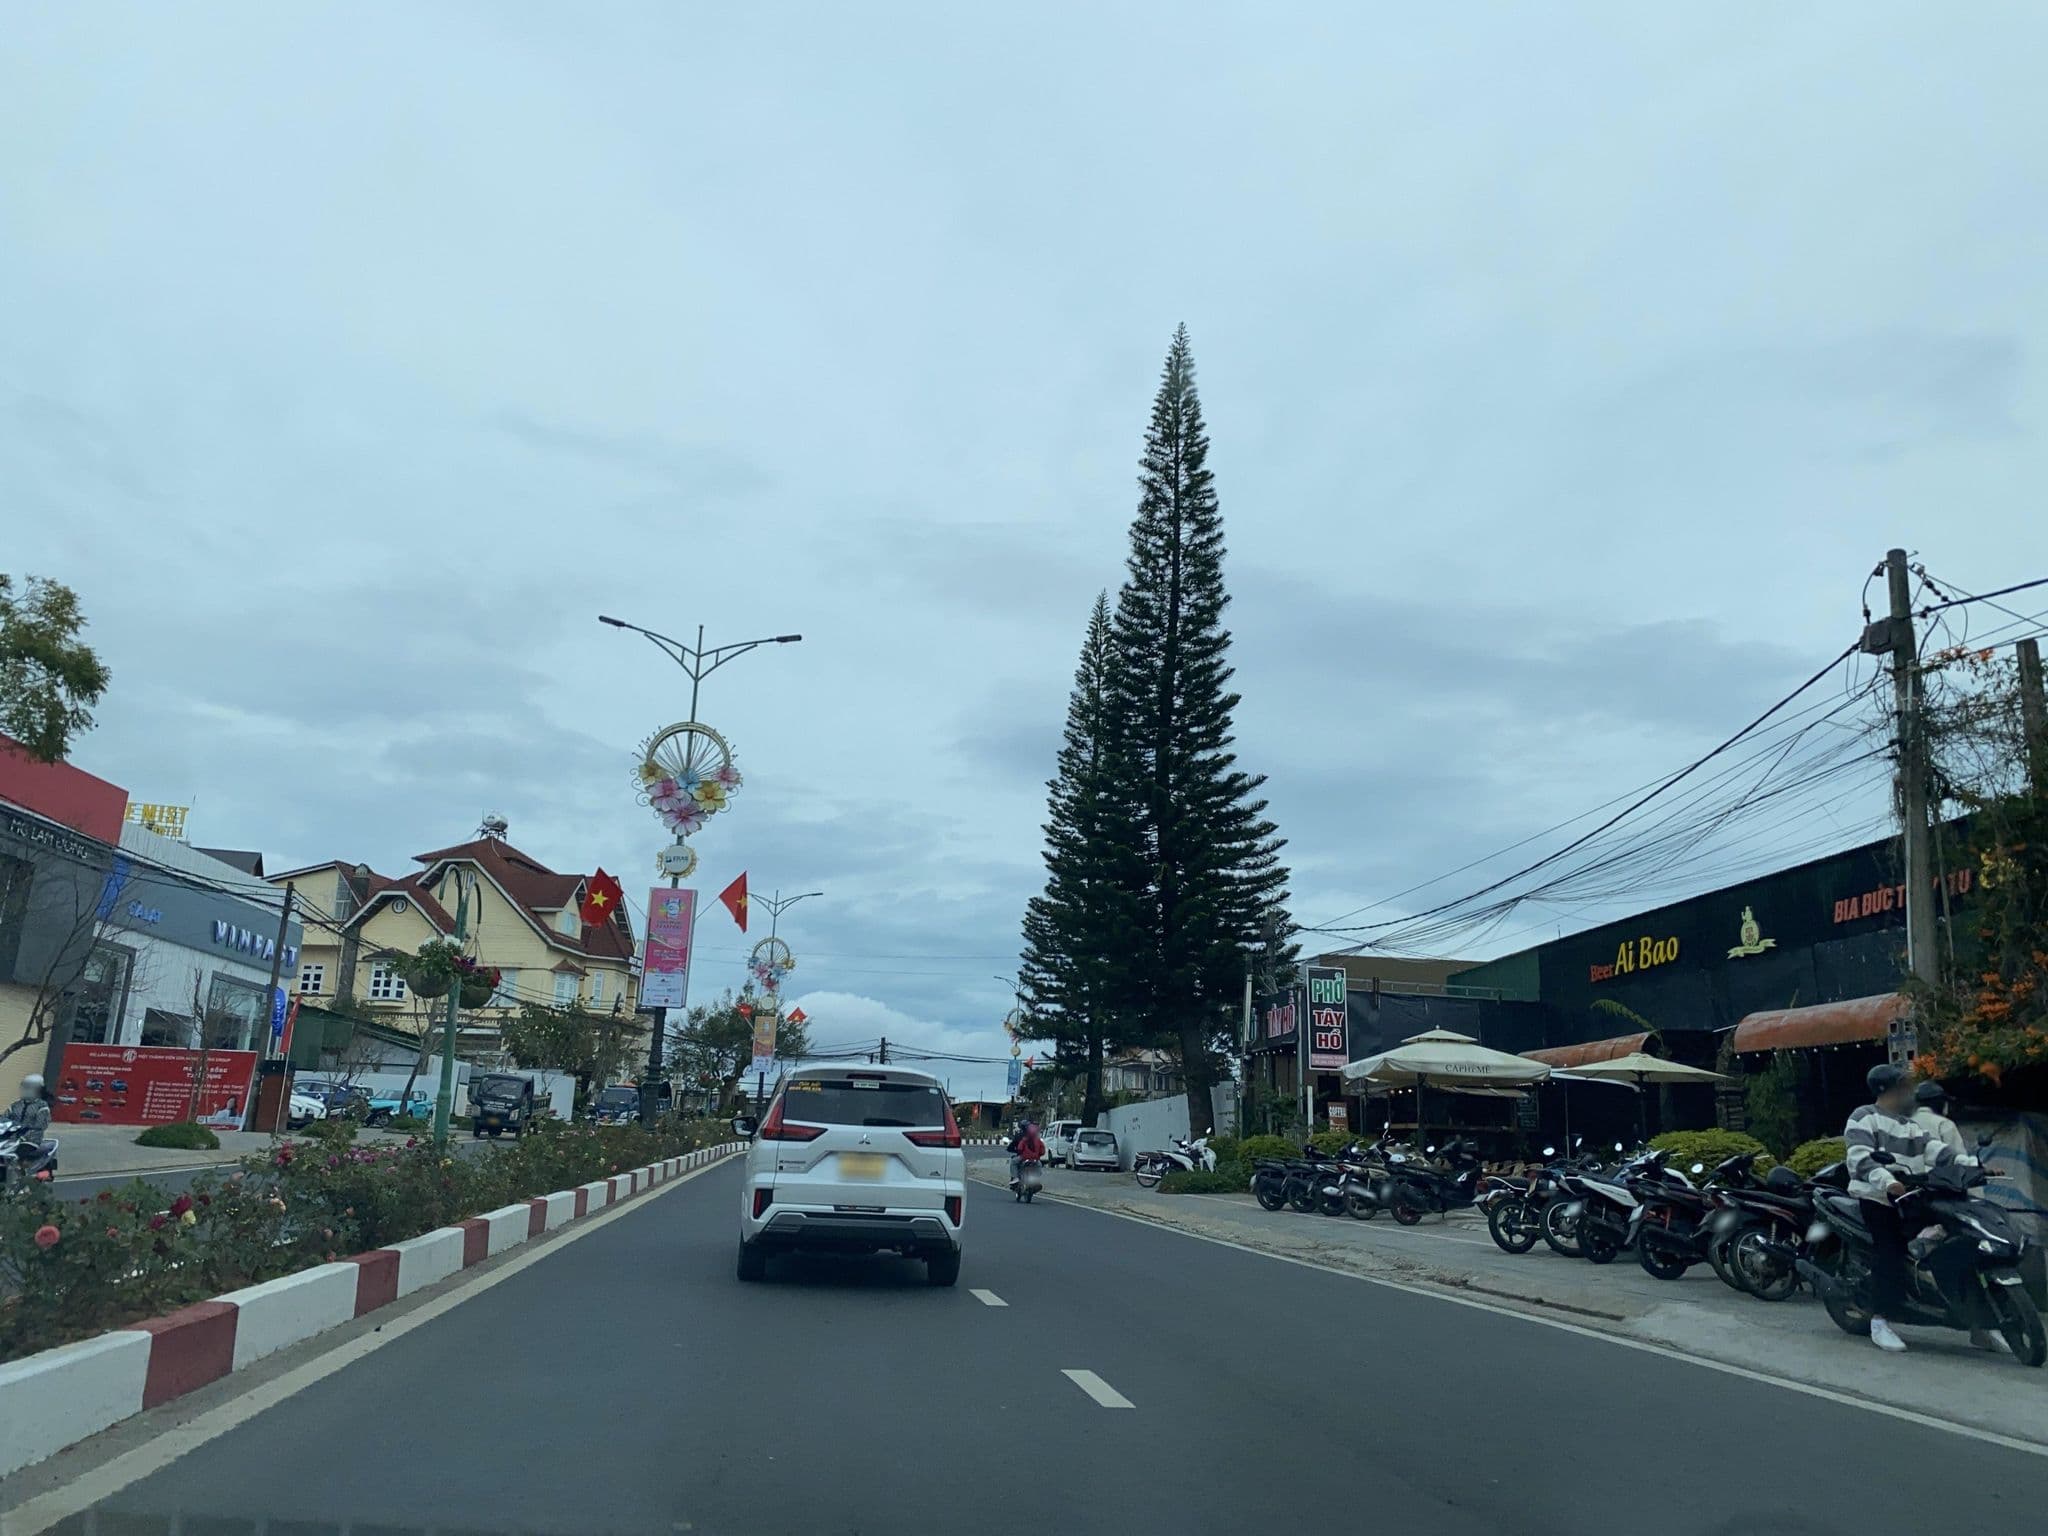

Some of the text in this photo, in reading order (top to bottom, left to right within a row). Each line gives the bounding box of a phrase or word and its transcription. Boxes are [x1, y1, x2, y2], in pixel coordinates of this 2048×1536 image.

[143, 804, 189, 824] MIST
[1834, 898, 1861, 923] BIA
[1614, 941, 1634, 975] Ai
[1639, 936, 1678, 970] Bao
[1311, 972, 1344, 1004] PHỞ
[1313, 1008, 1344, 1027] TÂY
